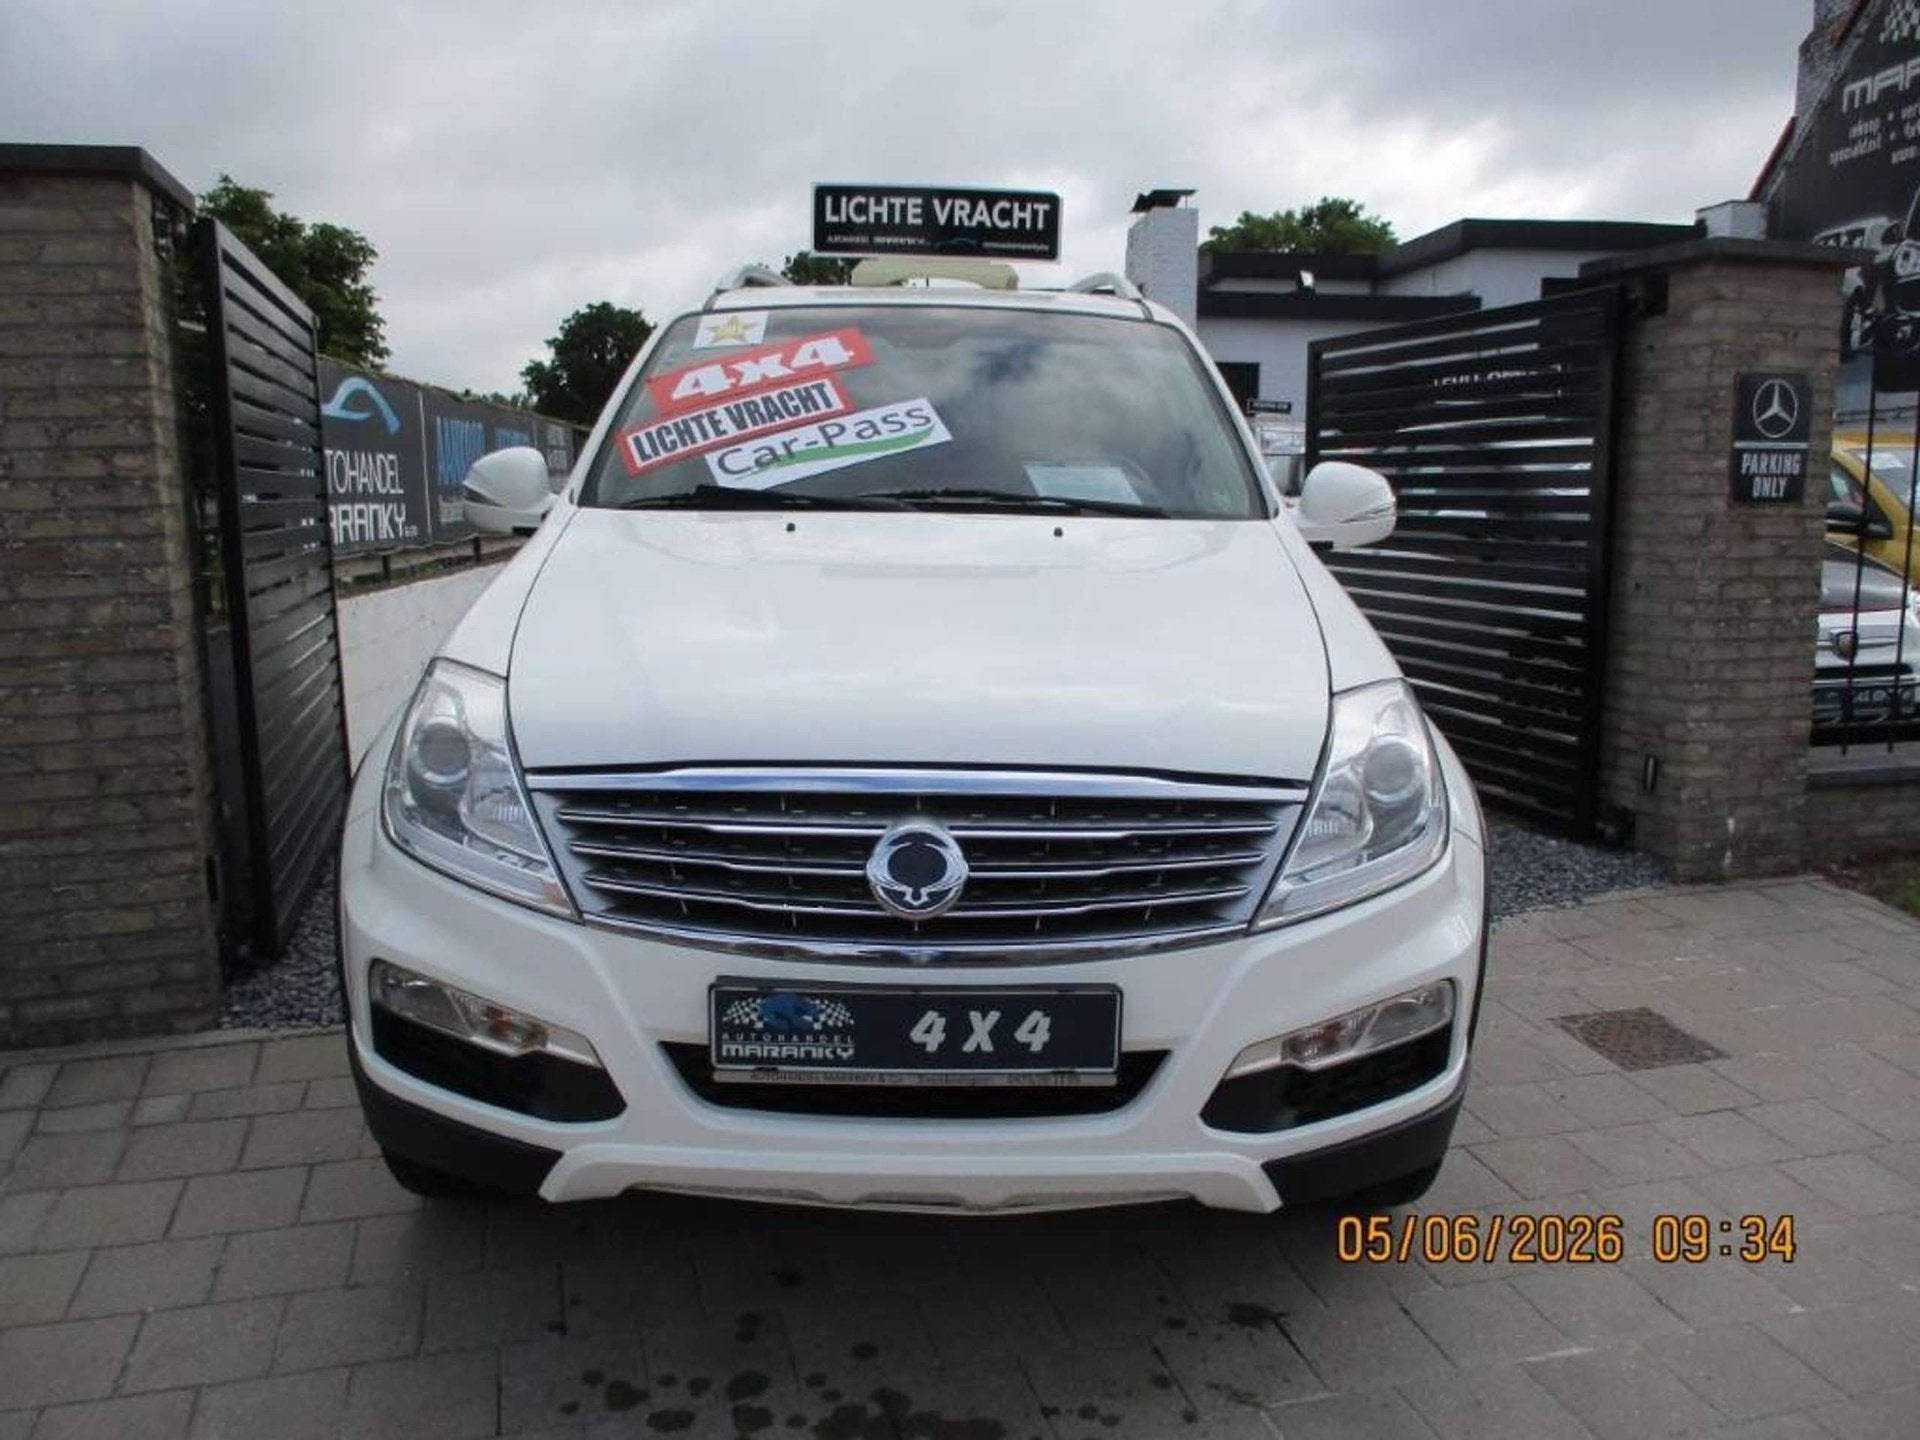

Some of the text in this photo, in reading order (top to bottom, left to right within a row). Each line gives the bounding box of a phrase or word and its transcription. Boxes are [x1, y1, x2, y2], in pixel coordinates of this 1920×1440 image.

[824, 195, 1050, 231] LICHTE VRACHT
[671, 336, 855, 400] 4x4
[632, 381, 836, 463] LICHTE VRACHT
[717, 406, 933, 476] Car-Pass
[324, 449, 404, 494] TOHANDEL
[1741, 452, 1801, 475] PARKING
[1752, 476, 1788, 498] ONLY
[721, 1032, 852, 1044] AUTOHANDEL
[909, 1009, 947, 1053] 4
[1013, 1009, 1051, 1053] 4
[721, 1043, 855, 1060] MARANKY
